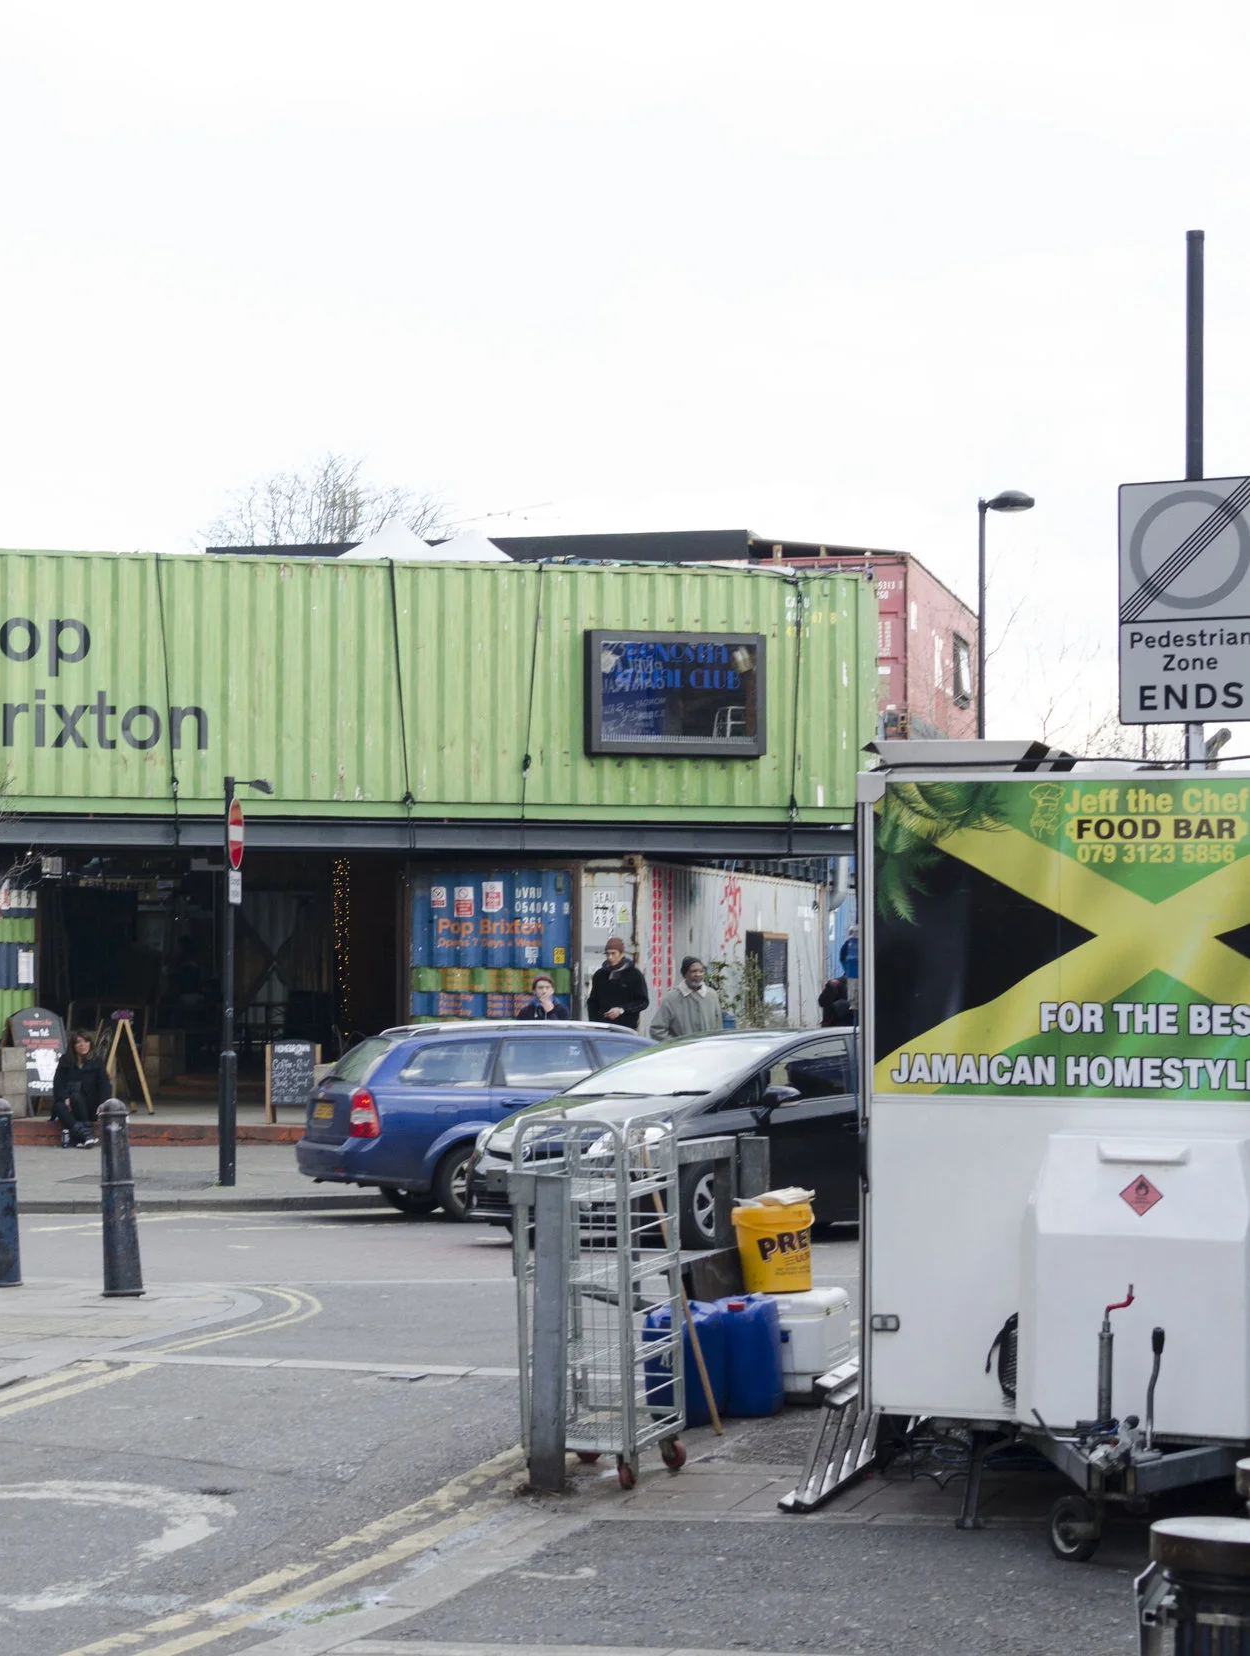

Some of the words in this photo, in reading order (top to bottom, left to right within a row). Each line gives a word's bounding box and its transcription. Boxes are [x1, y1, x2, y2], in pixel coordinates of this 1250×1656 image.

[1130, 628, 1250, 649] Pedestrian
[1163, 653, 1219, 672] Zone
[1139, 681, 1244, 711] ENDS
[1064, 788, 1119, 814] Jeff
[1126, 788, 1174, 814] the
[1181, 787, 1250, 813] Chef
[1076, 818, 1162, 840] FOOD
[1173, 818, 1236, 840] BAR
[1076, 843, 1118, 864] 079
[1122, 843, 1176, 864] 3123
[1181, 843, 1236, 864] 5856
[437, 918, 475, 937] Pop
[480, 917, 544, 936] Brixton
[1039, 1001, 1105, 1035] FOR
[1112, 1002, 1180, 1036] THE
[890, 1052, 1057, 1087] JAMAICAN
[1064, 1055, 1250, 1091] HOMESTYL
[756, 1228, 810, 1264] PRE
